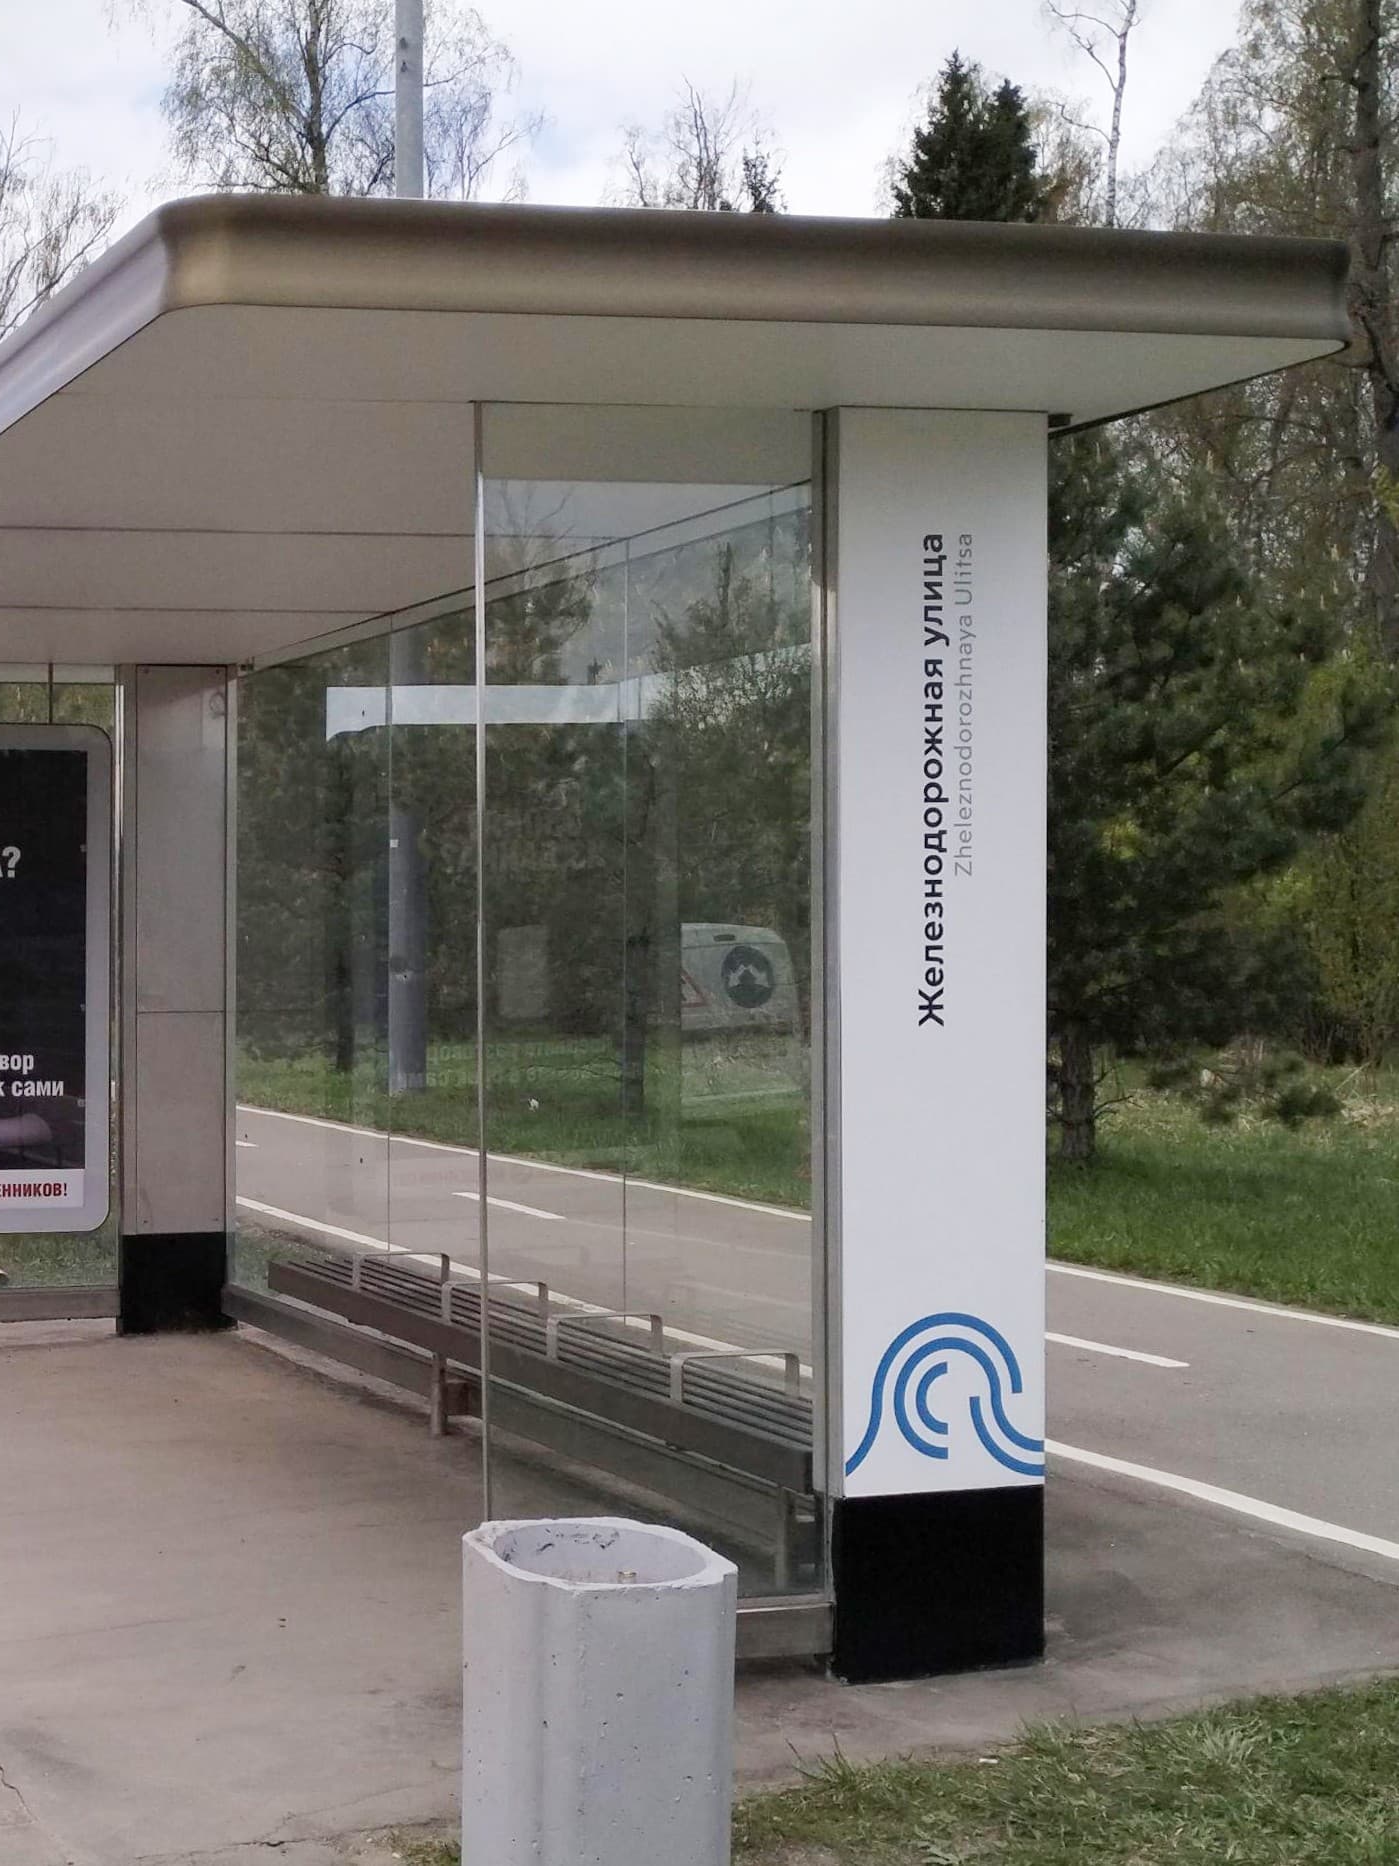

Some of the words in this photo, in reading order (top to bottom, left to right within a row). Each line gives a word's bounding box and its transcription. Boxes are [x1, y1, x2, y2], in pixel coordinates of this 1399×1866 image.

[923, 534, 950, 647] улица
[953, 534, 973, 605] Ulitsa
[954, 615, 976, 877] Zheleznodorozhnaya
[918, 658, 949, 1027] Железнодорожная
[11, 1080, 65, 1097] сами
